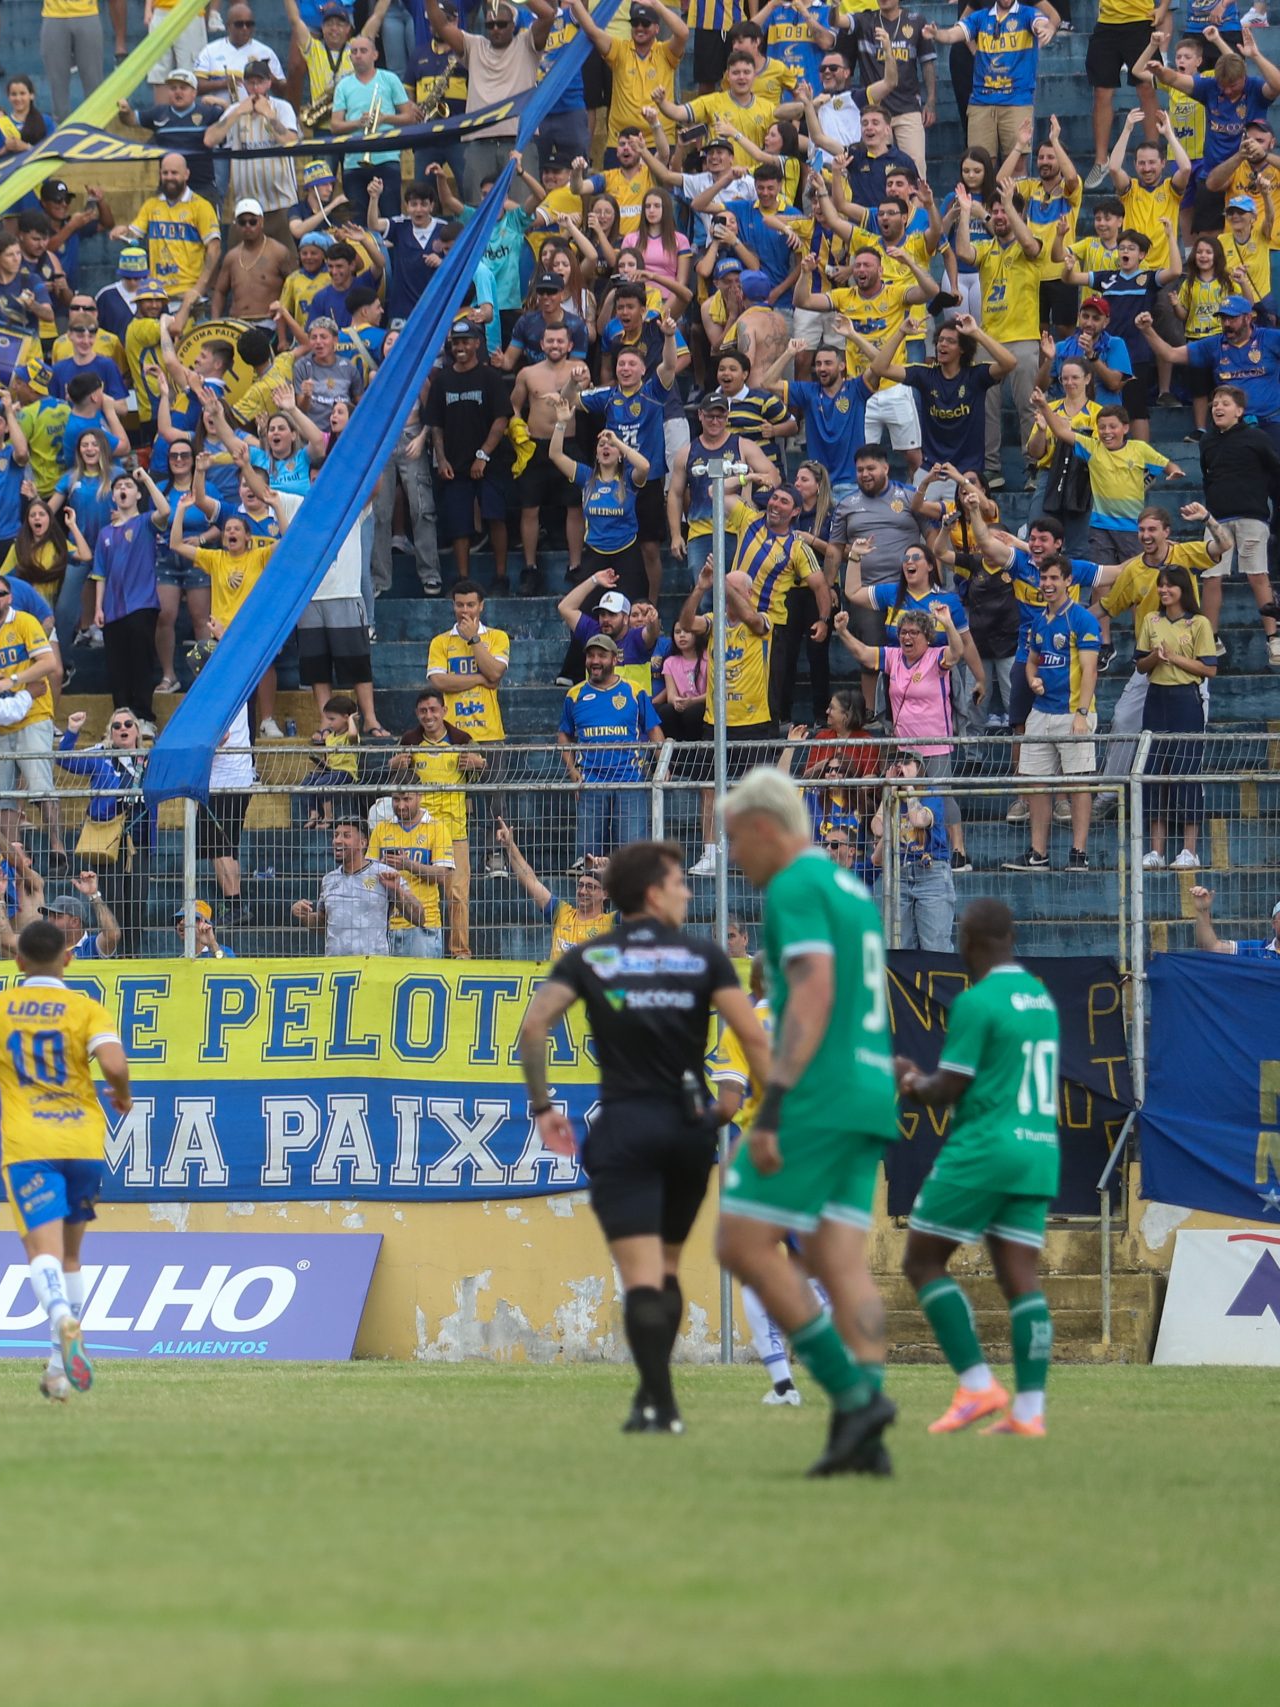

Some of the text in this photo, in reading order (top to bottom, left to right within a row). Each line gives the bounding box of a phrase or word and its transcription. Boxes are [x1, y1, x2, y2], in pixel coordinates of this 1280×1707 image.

[987, 284, 1007, 302] 21
[193, 330, 213, 342] UMA
[929, 403, 970, 420] dresch
[588, 506, 625, 517] MULTISOM
[1044, 654, 1062, 666] TIM
[454, 701, 485, 717] Bob's
[583, 725, 628, 738] MULTISOM
[861, 930, 884, 1034] 9
[198, 969, 603, 1069] PELOTA
[6, 1029, 67, 1087] 10
[1016, 1040, 1058, 1117] 10
[261, 1086, 600, 1188] PAIXÃ
[148, 1340, 269, 1355] ALIMENTOS
